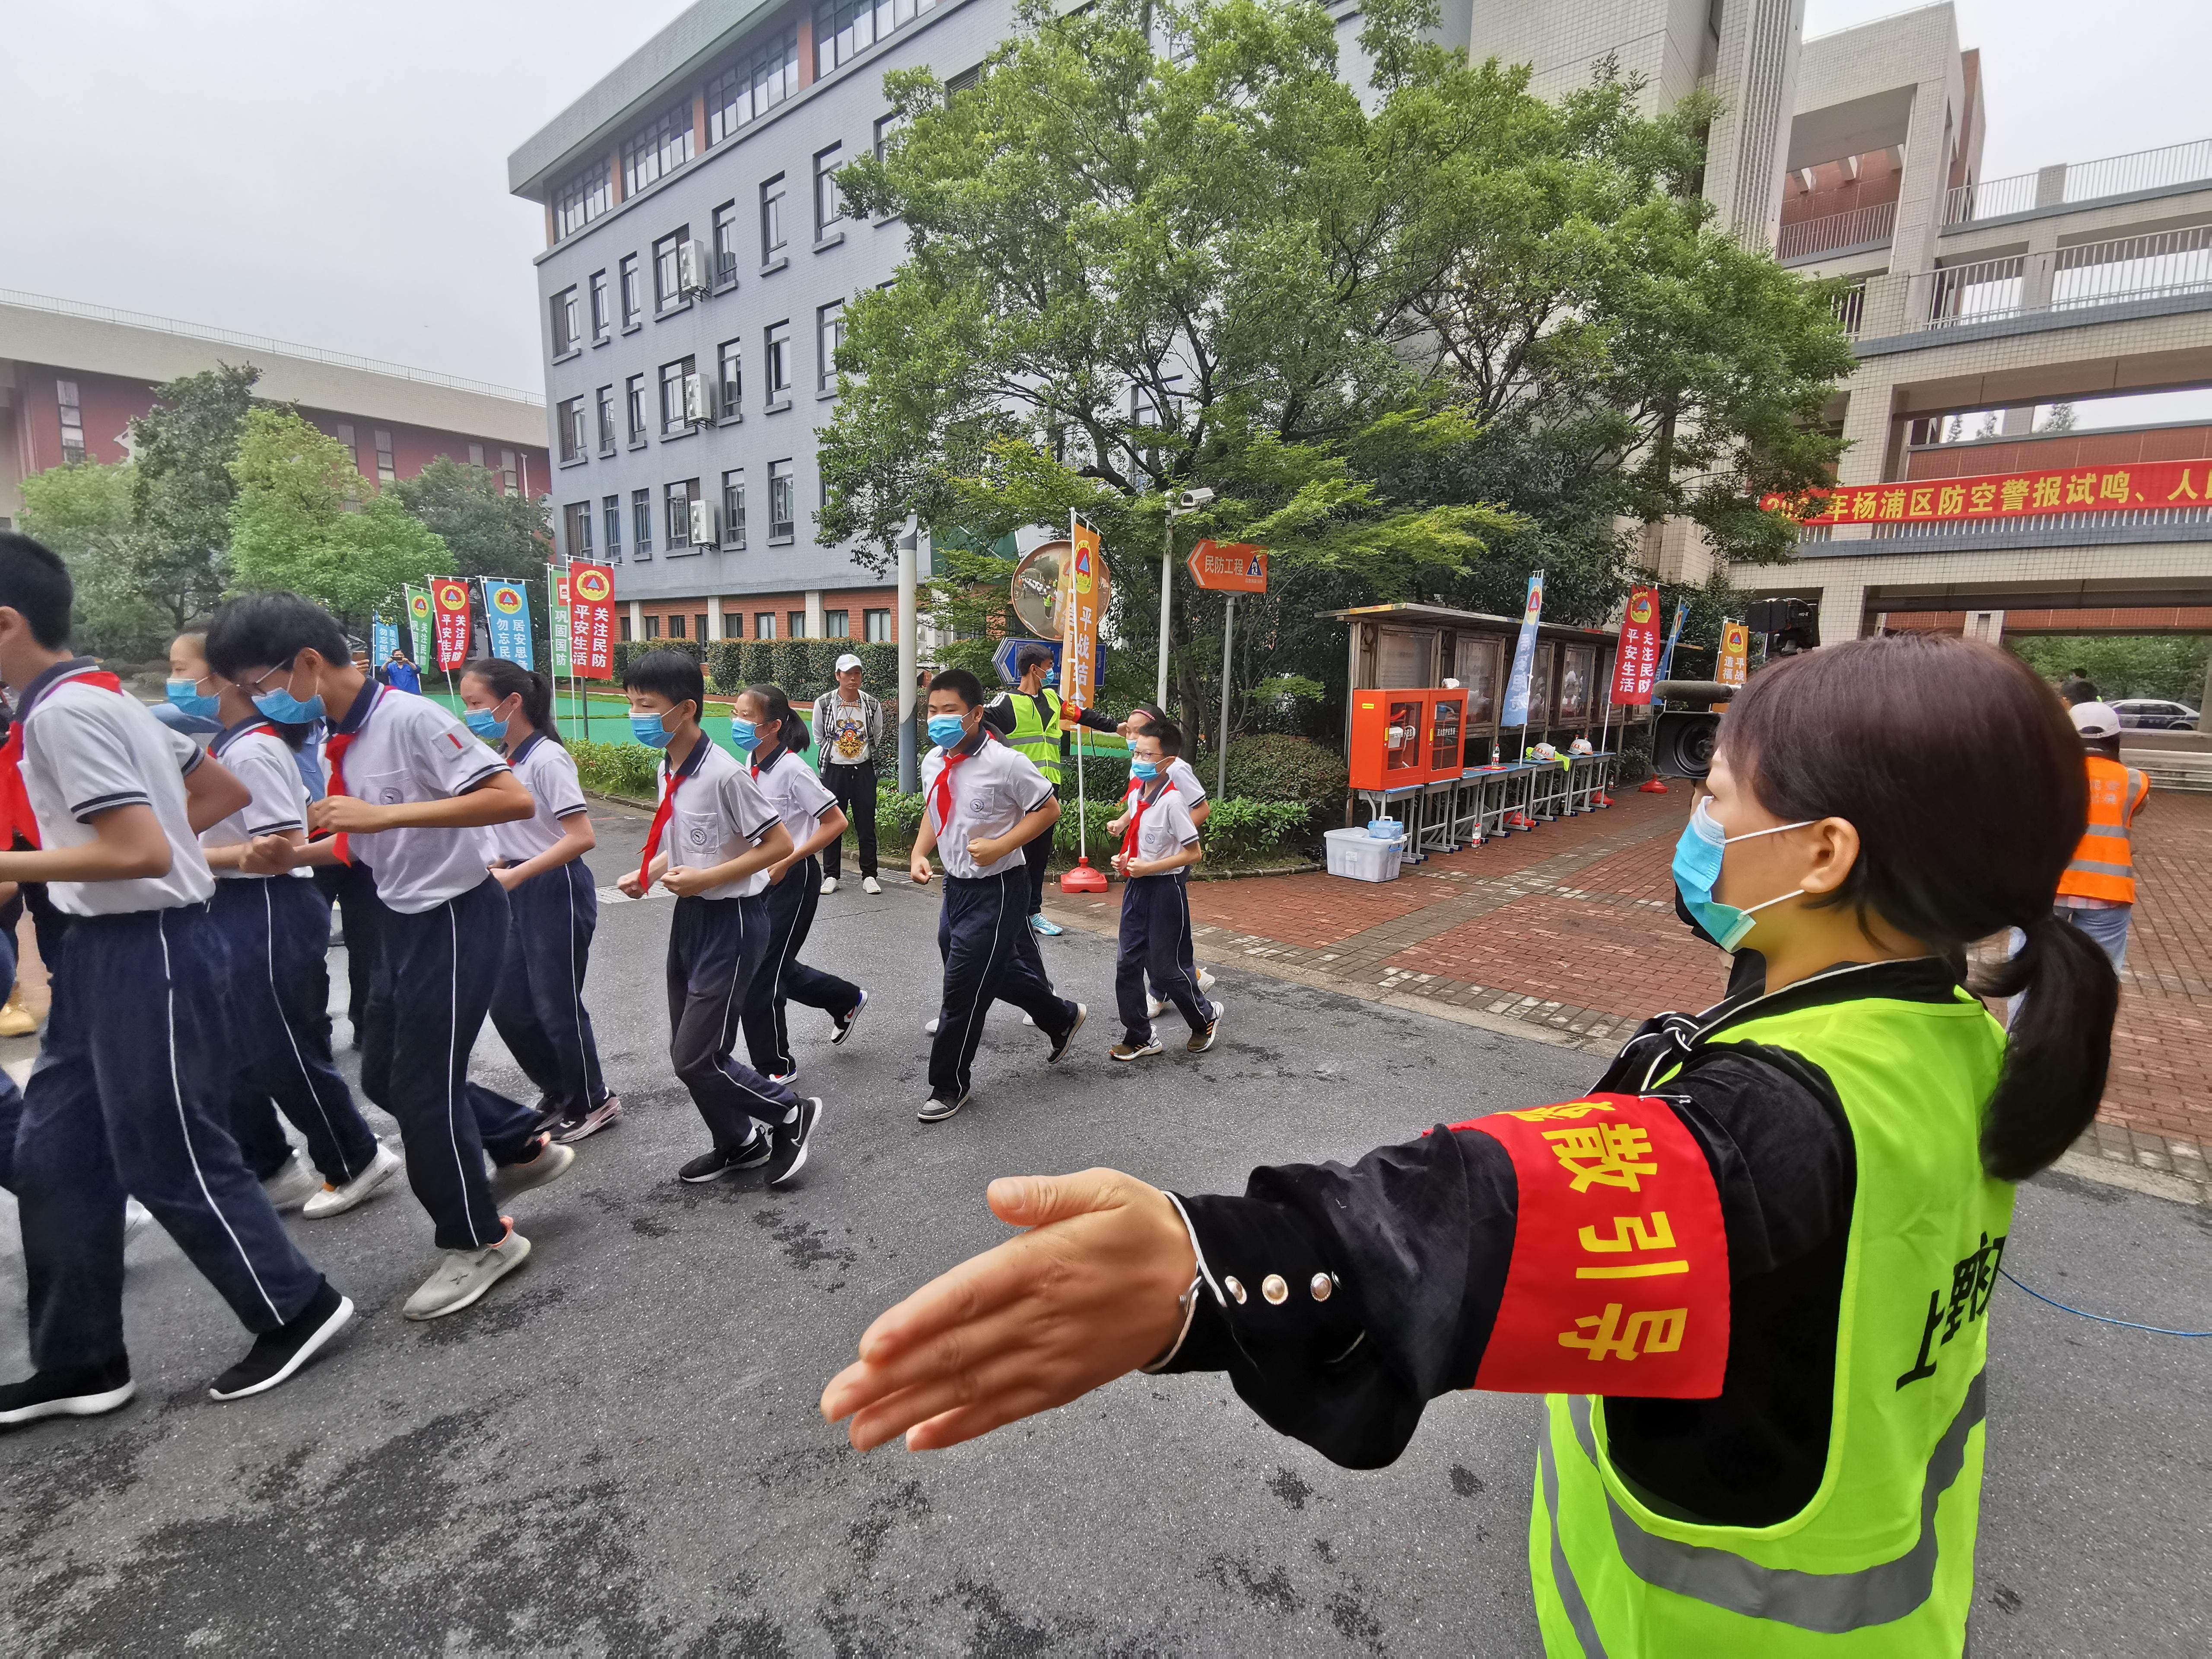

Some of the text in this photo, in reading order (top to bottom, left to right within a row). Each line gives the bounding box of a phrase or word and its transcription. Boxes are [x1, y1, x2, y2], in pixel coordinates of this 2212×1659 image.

[1205, 555, 1243, 575] 民防工程
[379, 628, 388, 661] 勿忘民防
[441, 614, 452, 662] 平安生活
[451, 615, 466, 661] 关注民防
[555, 610, 569, 666] 巩固国防
[573, 604, 590, 666] 平安生活
[592, 607, 609, 667] 关注民防
[1619, 628, 1639, 693] 平安生活
[1638, 631, 1654, 693] 关注民防
[1723, 656, 1733, 684] 造福
[1735, 657, 1744, 684] 平战
